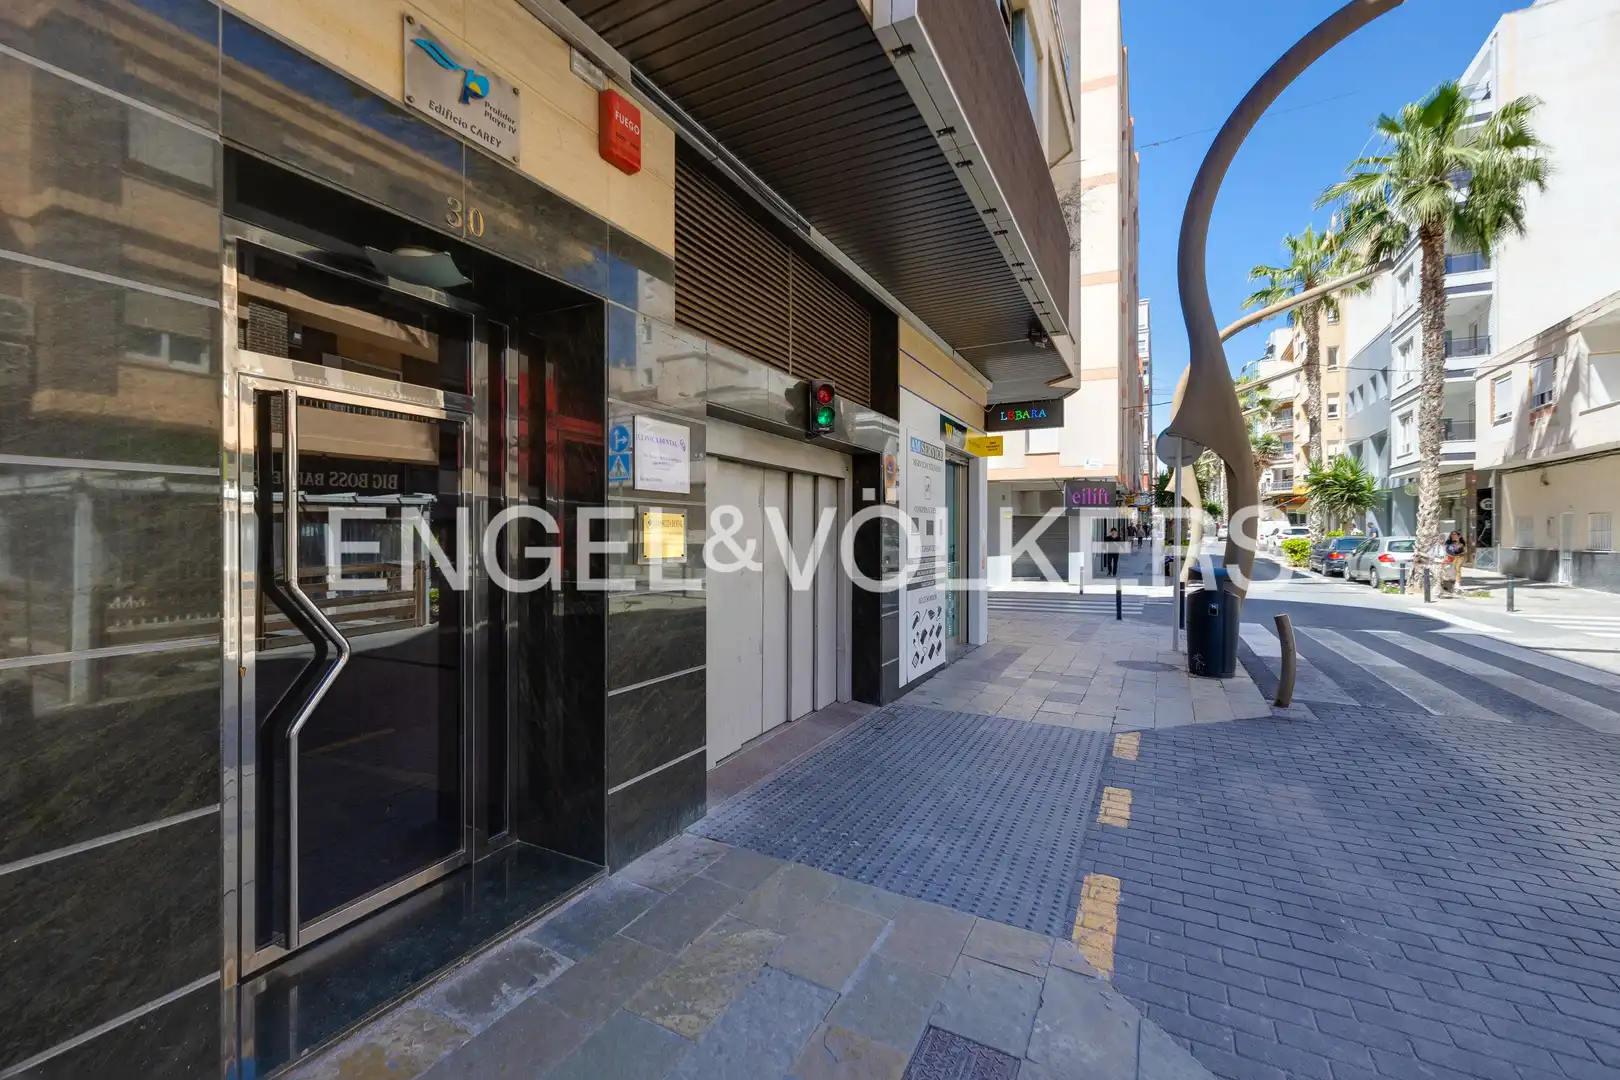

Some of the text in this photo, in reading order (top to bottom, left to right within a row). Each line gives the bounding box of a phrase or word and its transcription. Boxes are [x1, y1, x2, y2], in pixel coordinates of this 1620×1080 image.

[428, 99, 502, 148] Edificio CAREY
[615, 110, 640, 135] FUEGO
[446, 196, 485, 238] 30
[1000, 408, 1047, 421] LEBARA
